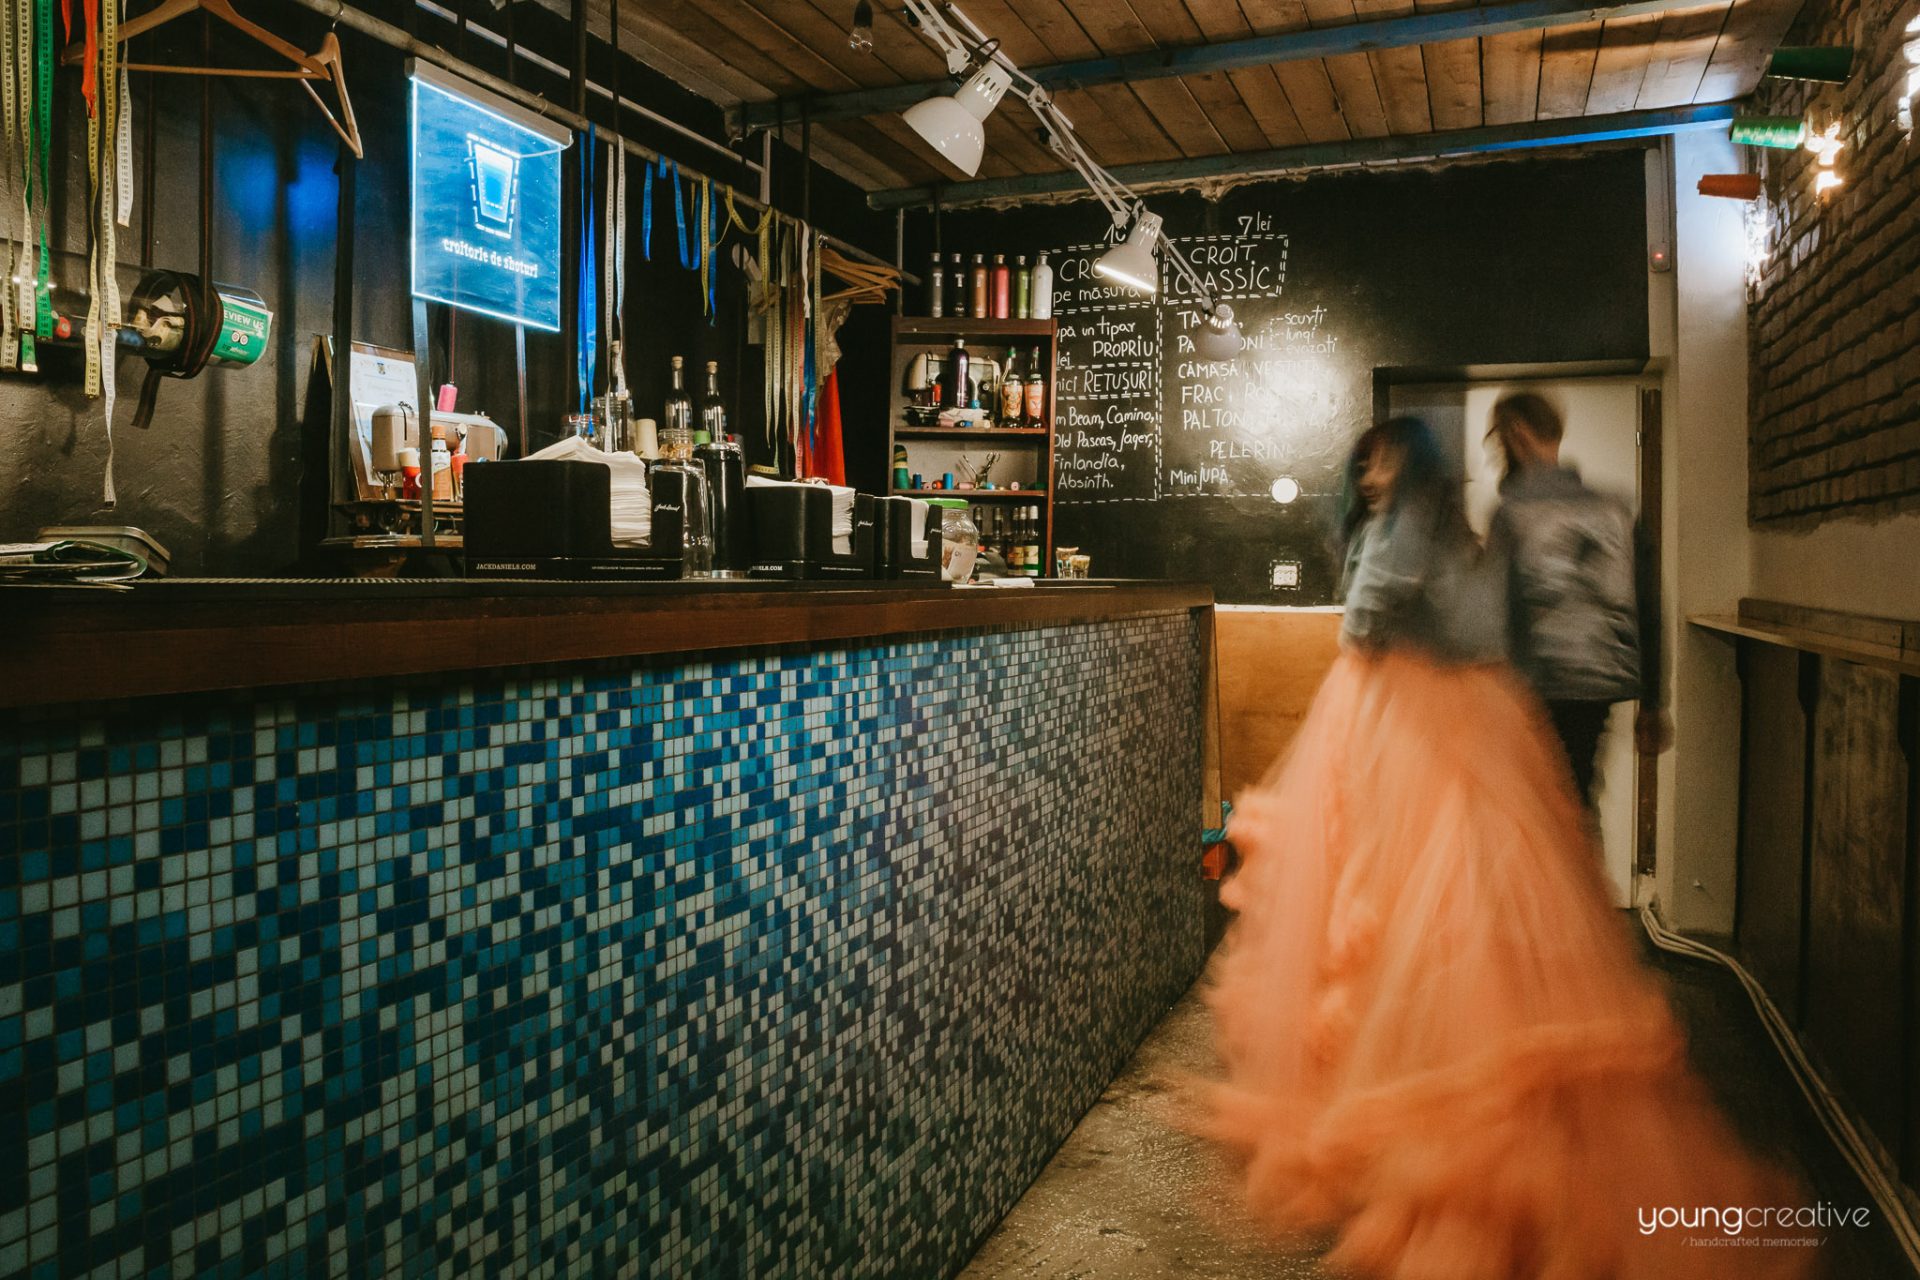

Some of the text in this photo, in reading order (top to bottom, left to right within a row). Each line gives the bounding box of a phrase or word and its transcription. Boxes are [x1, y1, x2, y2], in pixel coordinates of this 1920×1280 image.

[1256, 211, 1272, 233] lei
[490, 250, 503, 268] de
[1082, 326, 1095, 336] un
[1096, 315, 1136, 342] tipar
